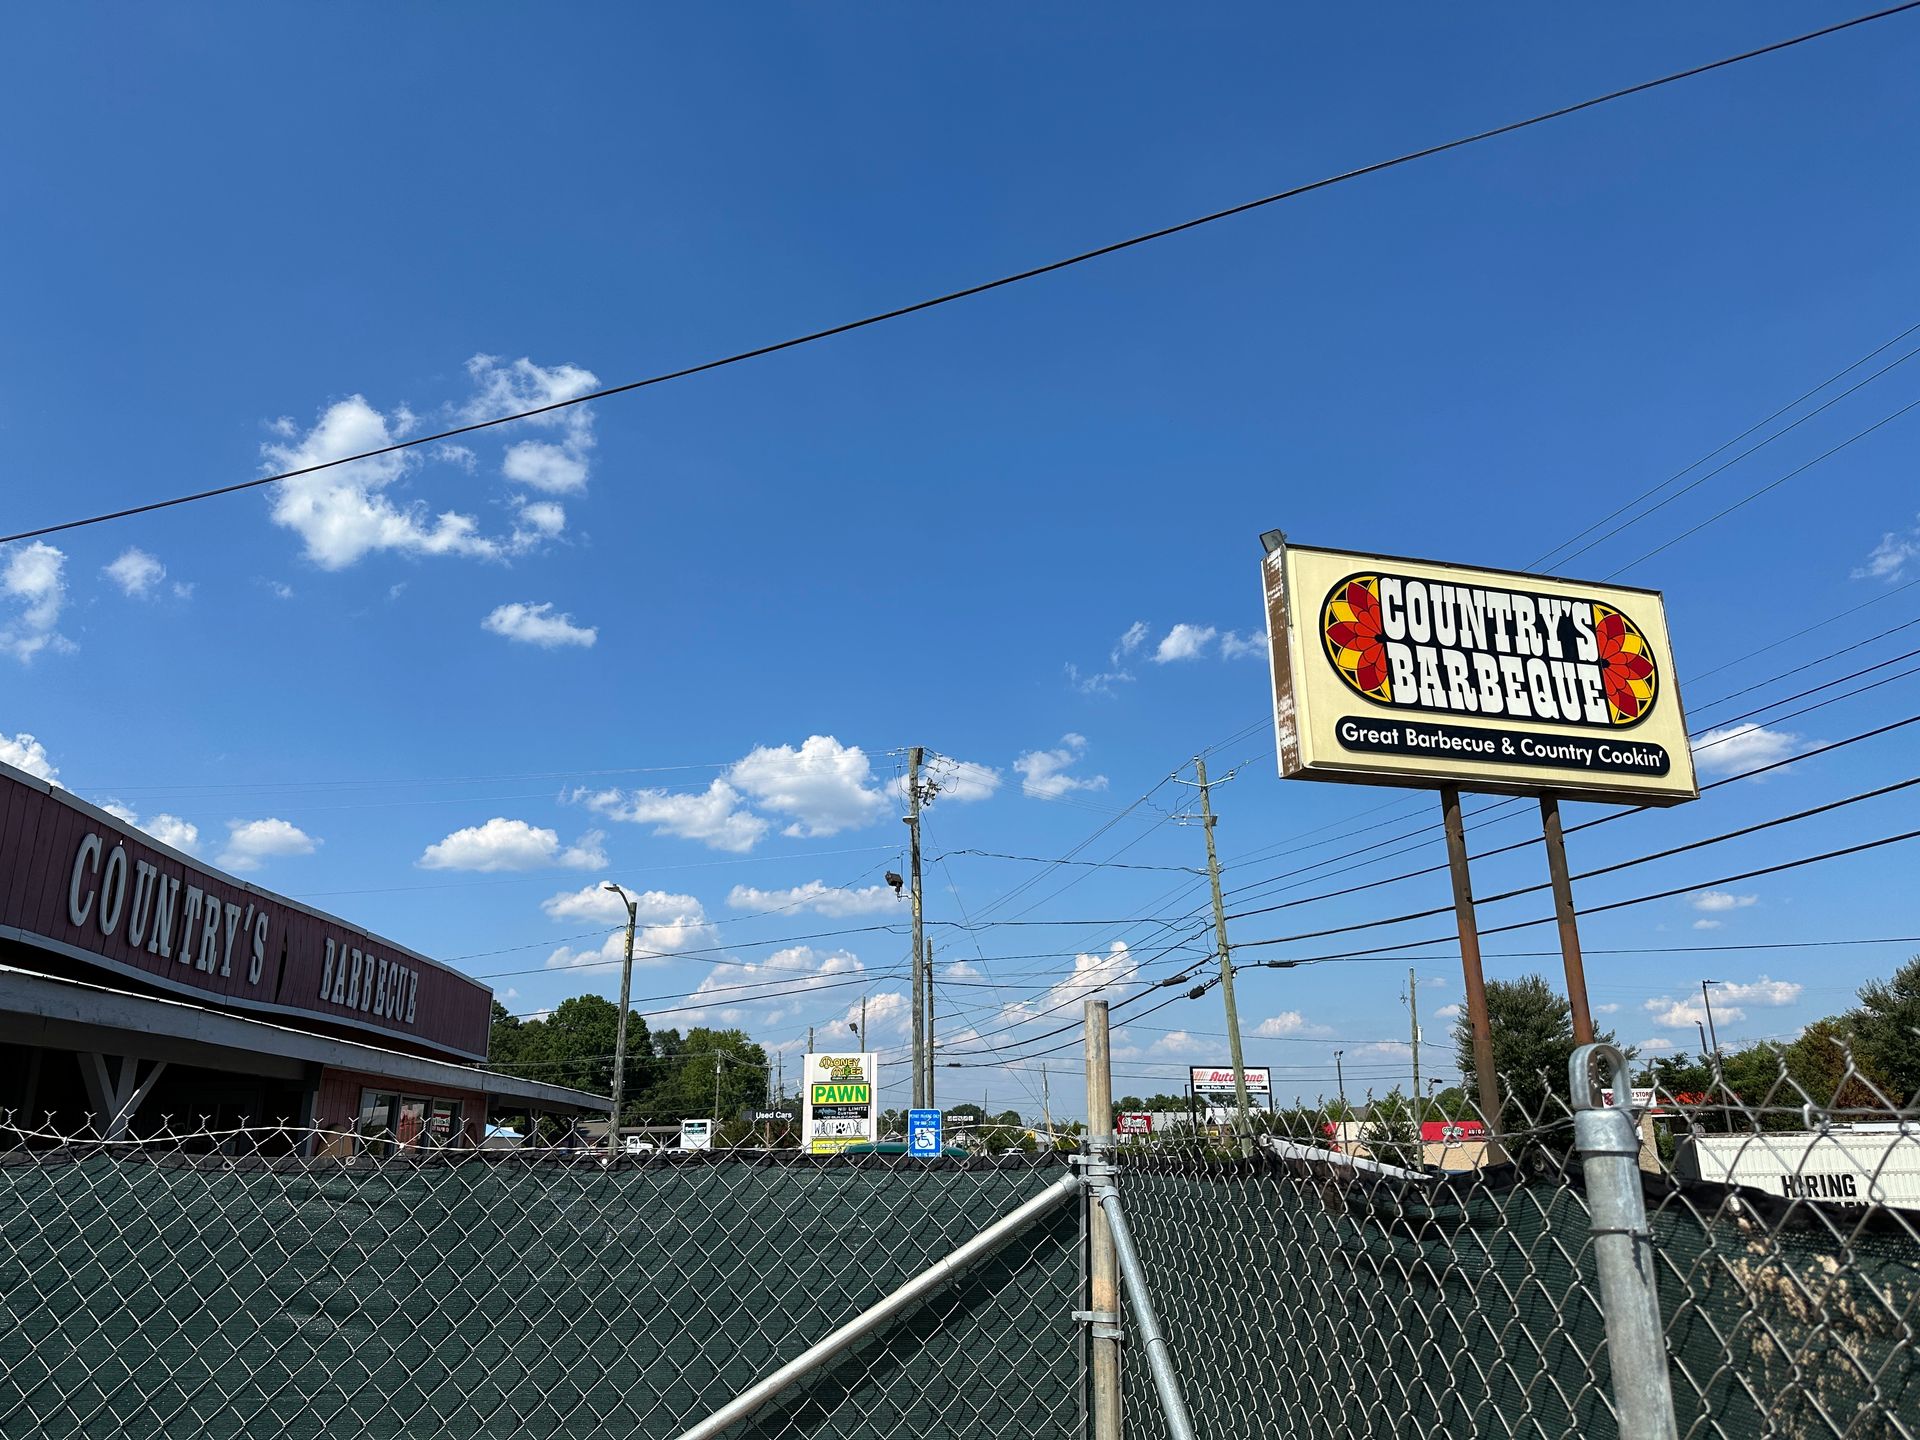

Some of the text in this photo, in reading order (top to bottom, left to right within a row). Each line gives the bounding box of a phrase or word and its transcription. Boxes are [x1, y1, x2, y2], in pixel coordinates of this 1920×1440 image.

[1379, 577, 1598, 663] COUNTRY'S
[1386, 642, 1611, 724] BARBEQUE
[1341, 723, 1664, 768] Great Barbecue & Country Cookin'
[69, 833, 419, 1024] COUNTRY'S BARBECUE
[819, 1056, 860, 1069] MONEY
[1209, 1071, 1264, 1083] Autoone
[815, 1086, 867, 1102] PAWN
